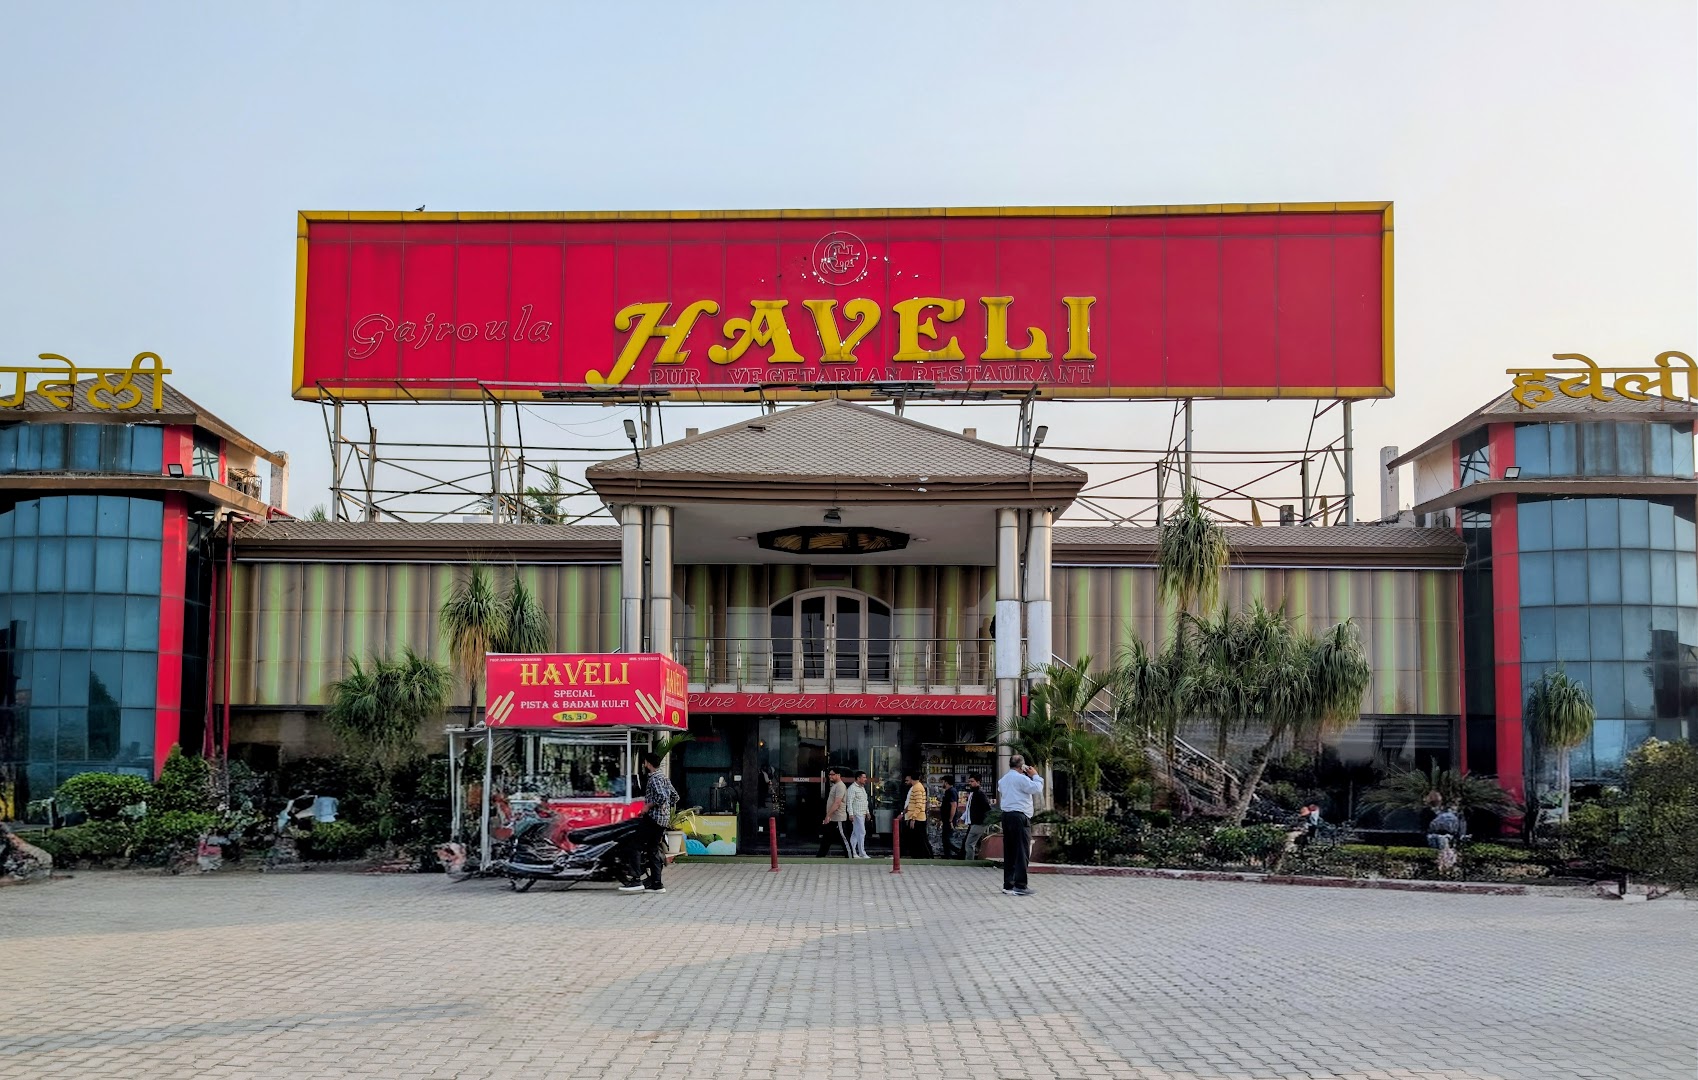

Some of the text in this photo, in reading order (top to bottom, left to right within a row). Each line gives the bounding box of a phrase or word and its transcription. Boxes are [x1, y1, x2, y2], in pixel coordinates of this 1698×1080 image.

[348, 304, 552, 360] Gajroula
[584, 296, 1098, 390] HAVELI
[727, 366, 903, 384] VEGETARIAN
[911, 364, 1096, 384] RESTAURANT
[1506, 351, 1698, 409] हवेली
[519, 658, 630, 686] HAVELI
[553, 689, 596, 698] SPECIAL
[687, 693, 735, 708] Pure
[874, 695, 997, 711] Restaurant
[520, 699, 630, 709] PISTA & BADAM KULFI
[561, 713, 575, 721] Rs.
